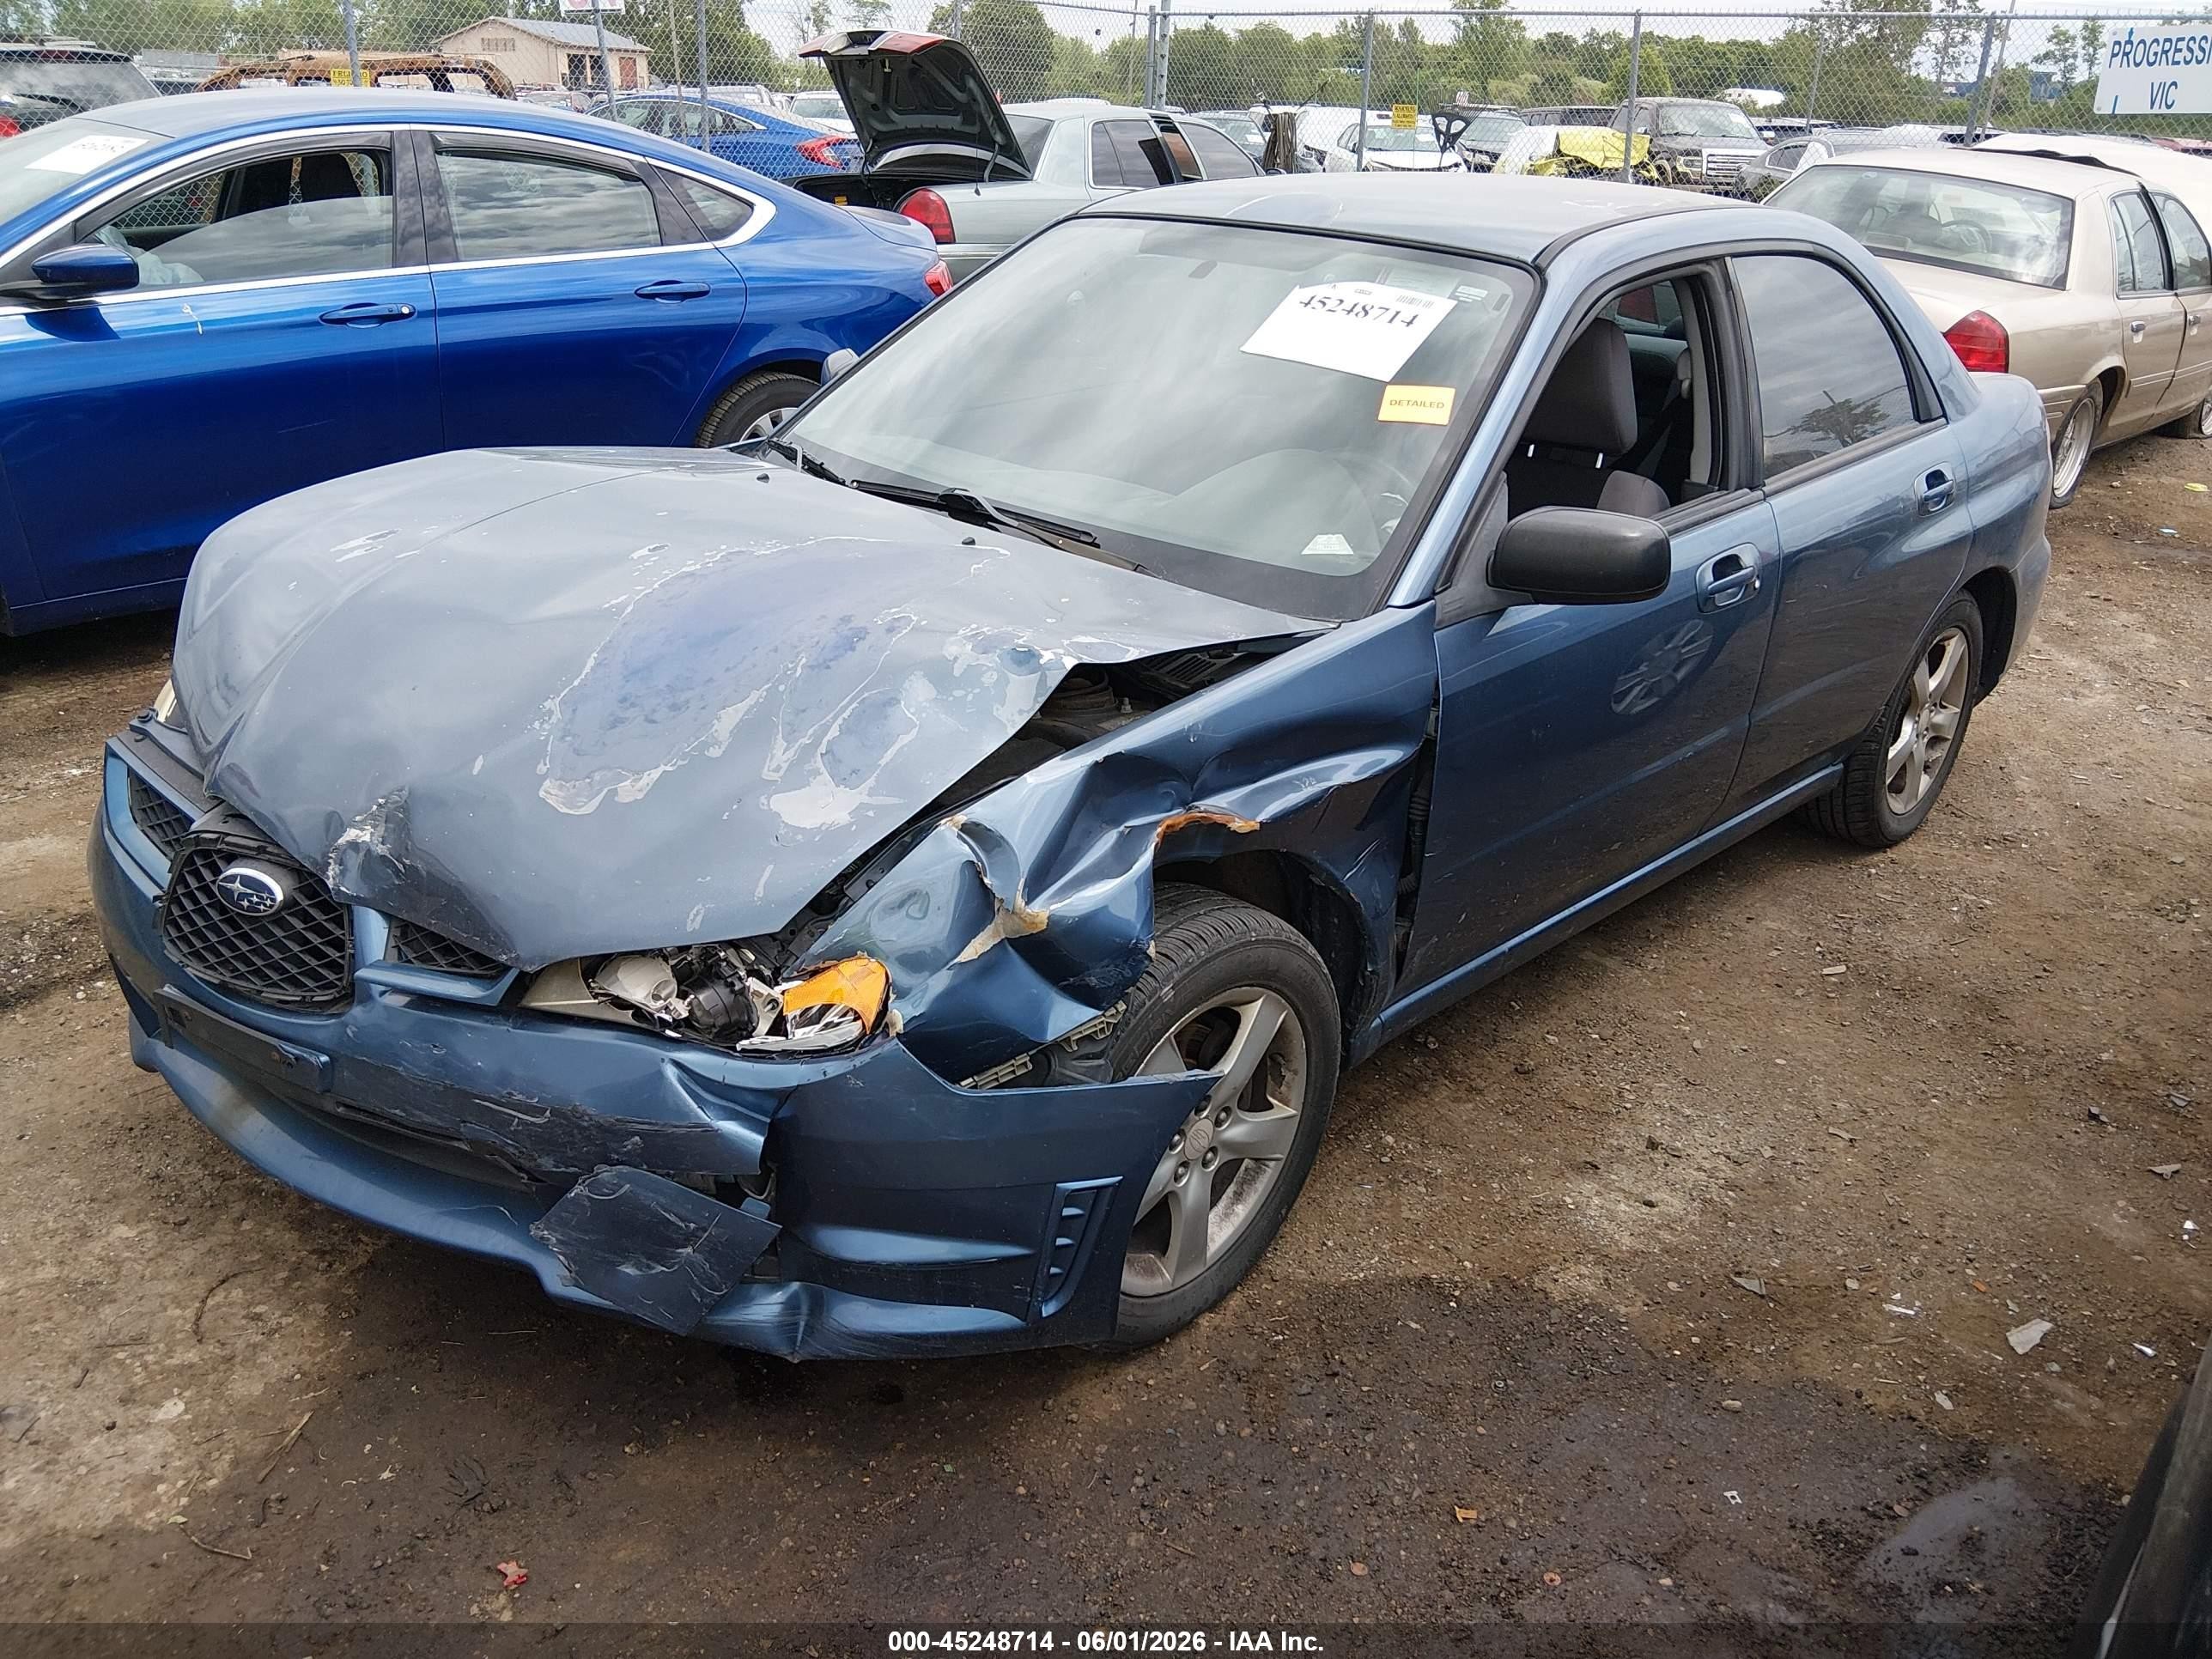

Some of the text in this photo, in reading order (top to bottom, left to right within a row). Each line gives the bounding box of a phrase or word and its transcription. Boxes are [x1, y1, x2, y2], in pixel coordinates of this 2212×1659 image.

[2150, 81, 2179, 110] VIC
[1299, 295, 1419, 327] 45248714
[1389, 399, 1445, 410] DETAILED
